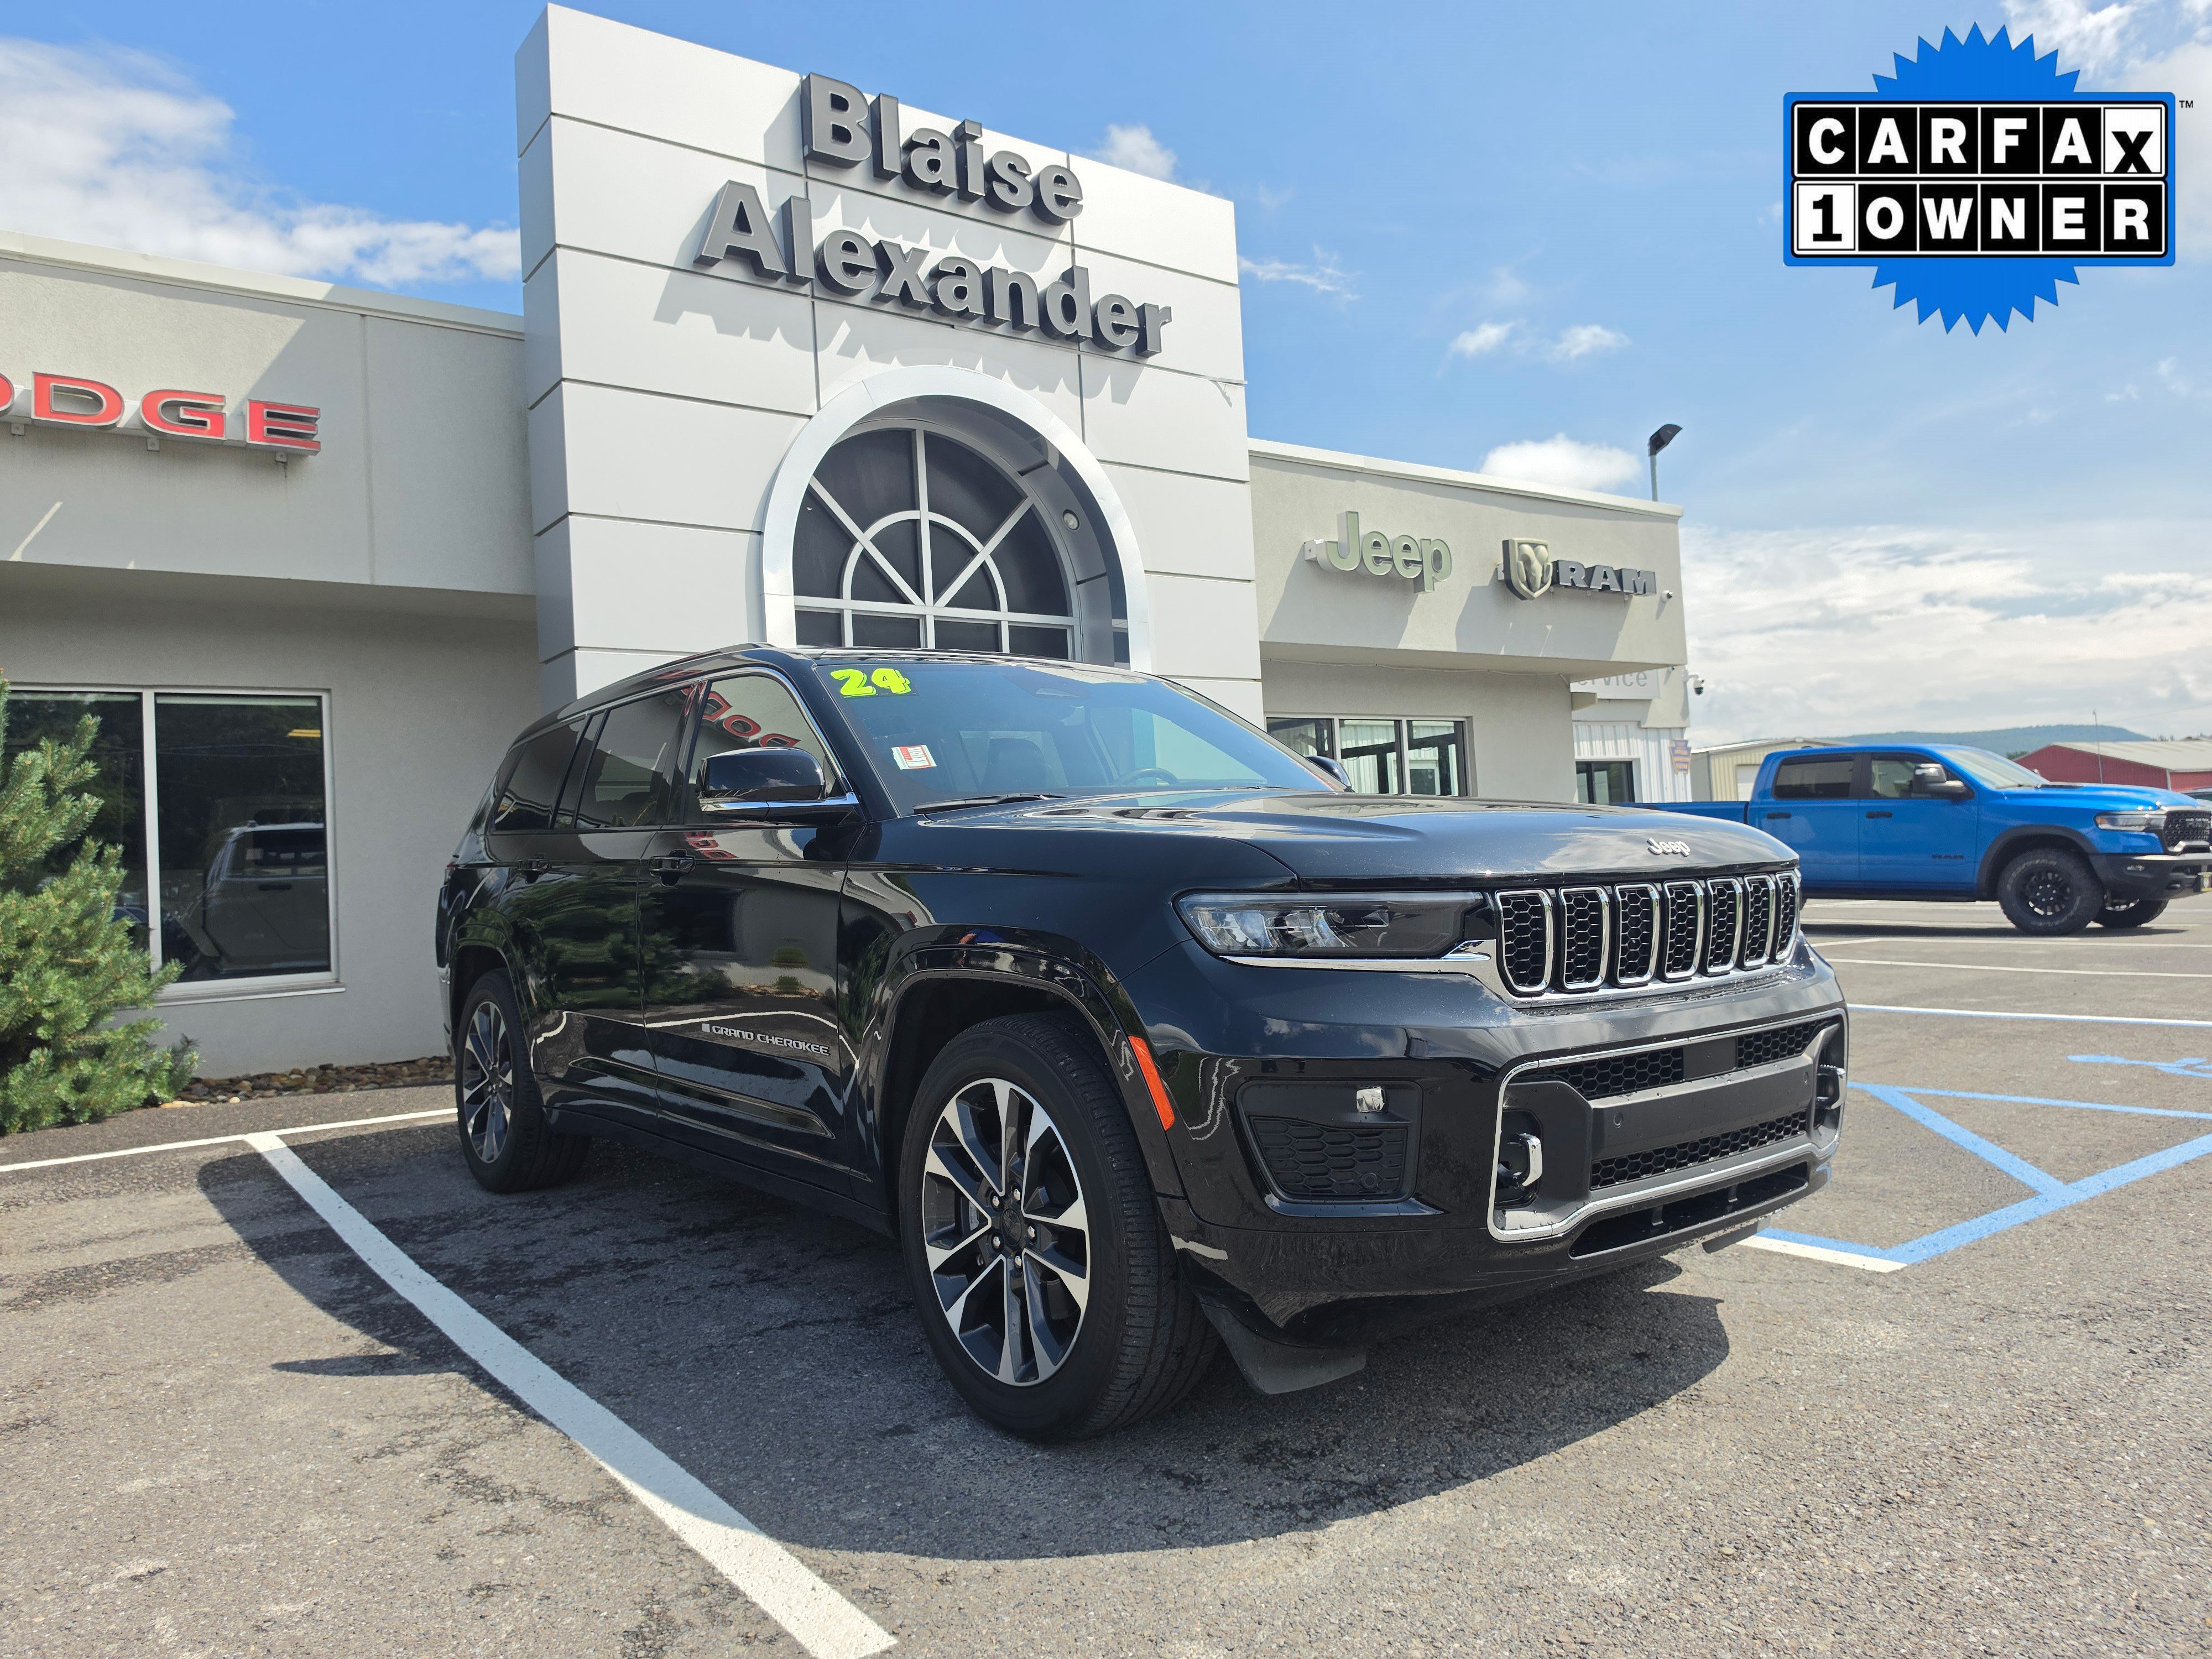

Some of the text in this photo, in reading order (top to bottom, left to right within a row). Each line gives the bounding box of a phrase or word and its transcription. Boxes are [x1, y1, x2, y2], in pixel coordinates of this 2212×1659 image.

[802, 72, 1083, 226] Blaise
[693, 180, 1172, 357] Alexander
[0, 372, 321, 455] DGE
[1317, 511, 1452, 593] Jeep
[1551, 560, 1656, 596] RAM
[830, 668, 911, 697] 24
[1647, 838, 1691, 857] Jeep
[712, 1025, 830, 1056] GRAND CHEROKEE
